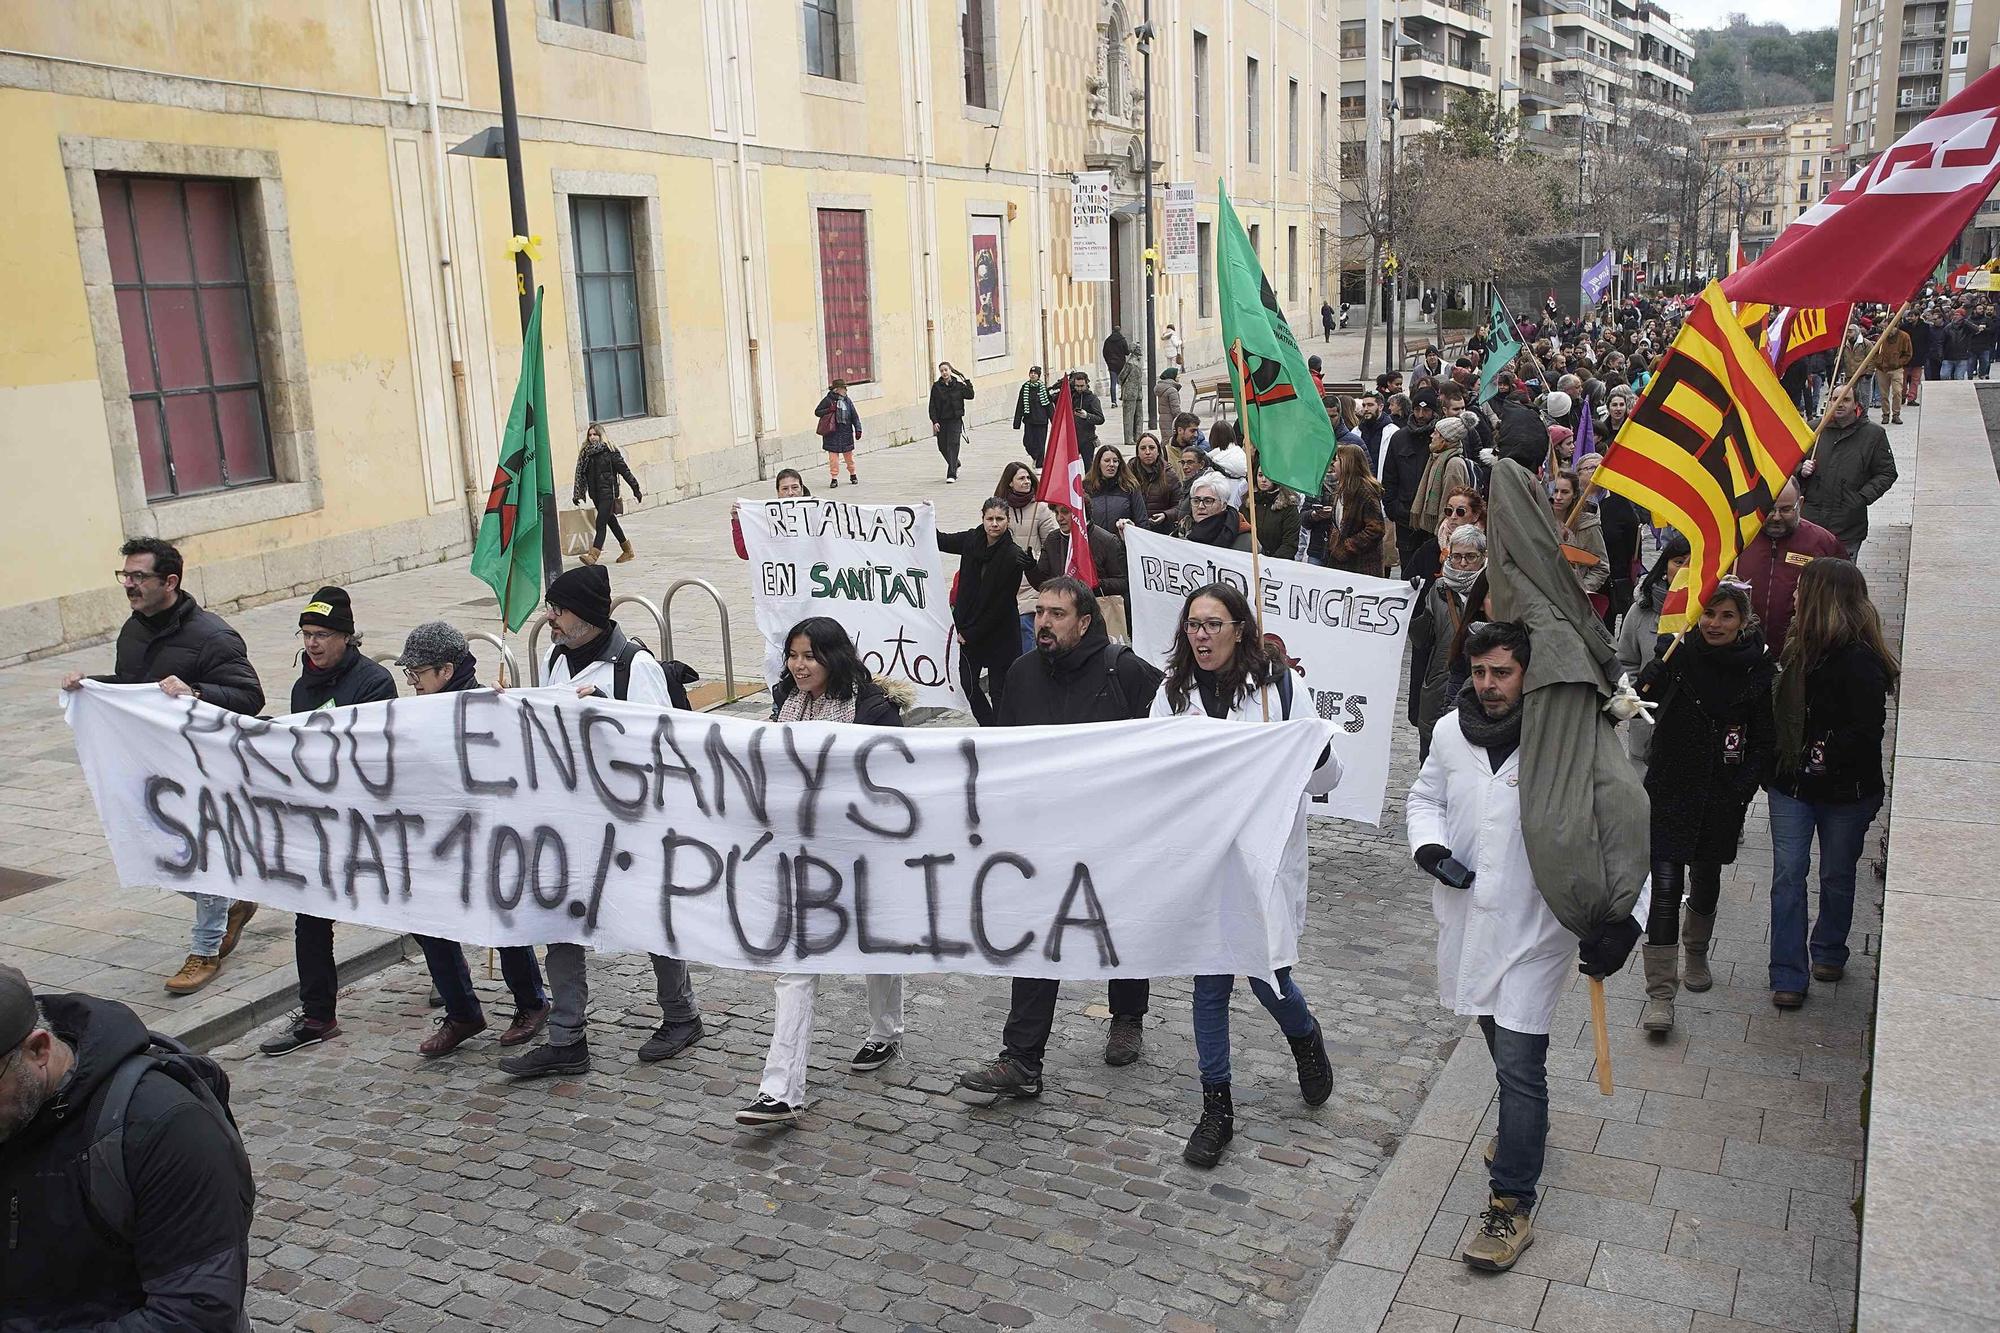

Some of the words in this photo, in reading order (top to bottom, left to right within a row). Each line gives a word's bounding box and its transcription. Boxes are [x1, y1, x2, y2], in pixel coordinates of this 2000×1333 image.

[1073, 205, 1105, 214] CAMPS
[1079, 184, 1097, 194] PEP
[765, 500, 916, 548] RETALLAR
[762, 561, 796, 596] EN
[178, 696, 396, 797] PROU
[144, 774, 425, 900] SANITAT
[660, 829, 1121, 968] PÚBLICA
